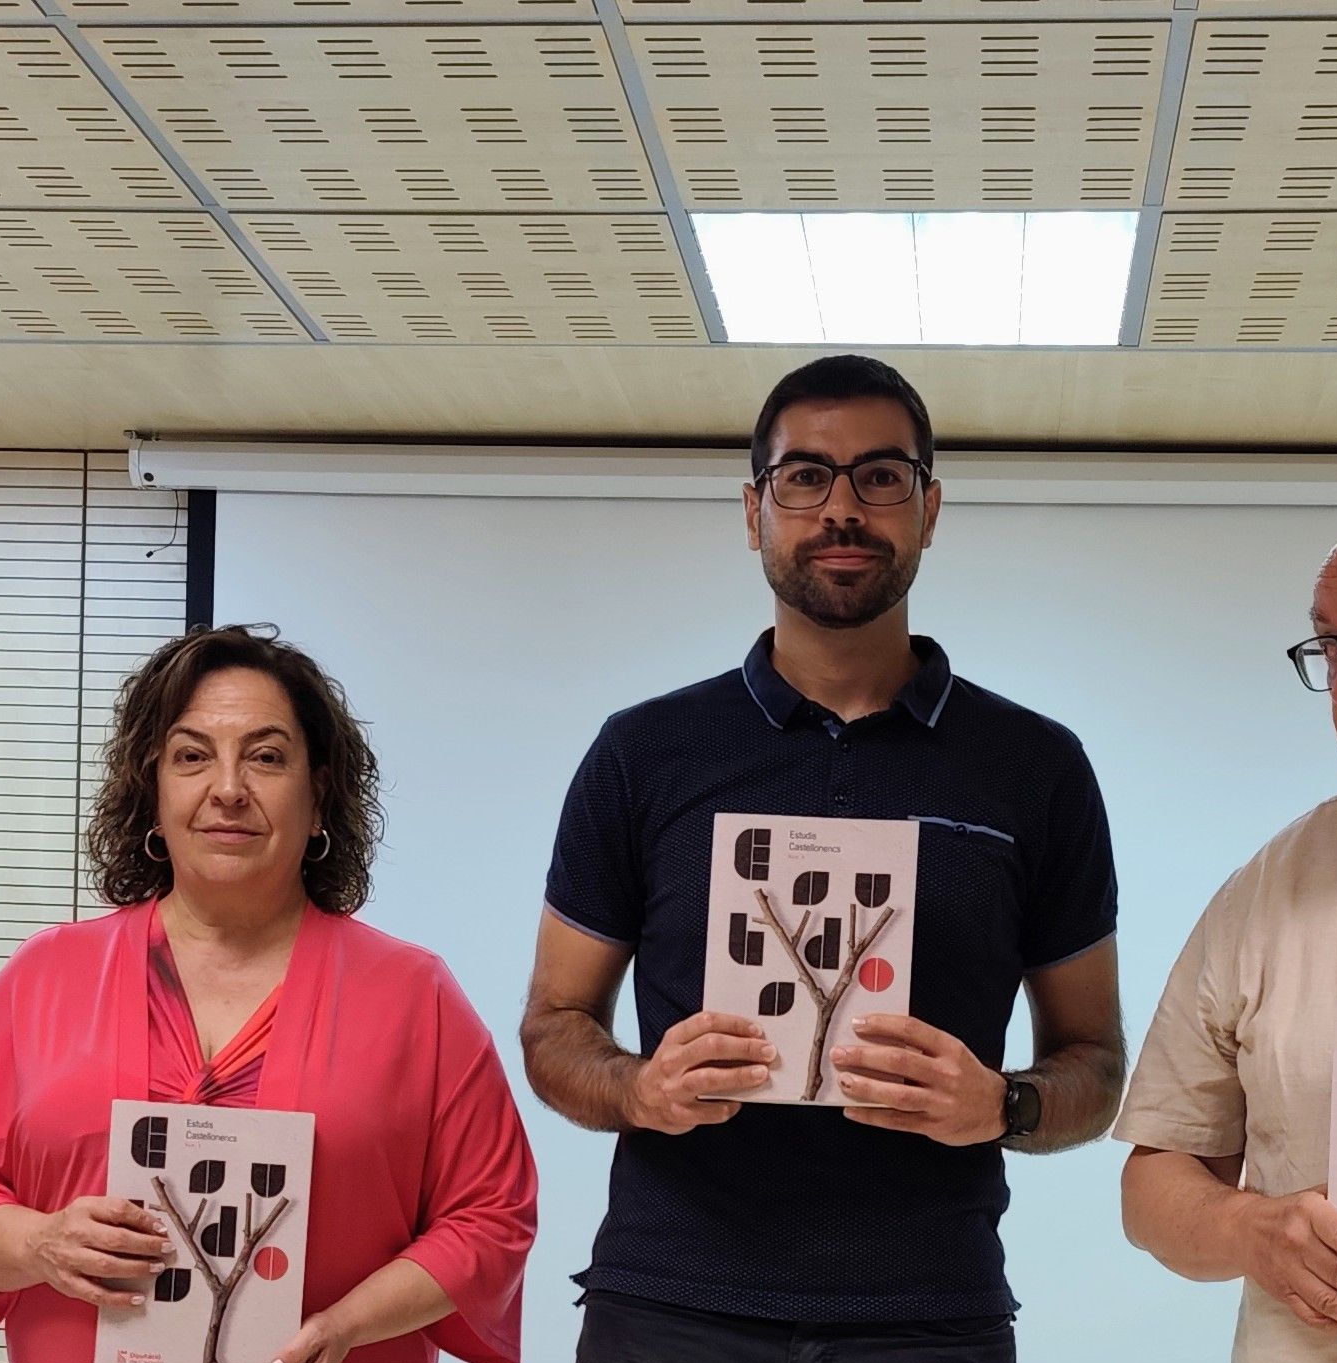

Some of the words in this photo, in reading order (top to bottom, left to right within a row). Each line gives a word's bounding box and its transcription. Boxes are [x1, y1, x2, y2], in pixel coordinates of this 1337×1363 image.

[789, 830, 817, 840] Estudis
[789, 842, 841, 853] Castellonencs
[186, 1118, 213, 1129] Estudis
[185, 1131, 238, 1143] Castellonencs
